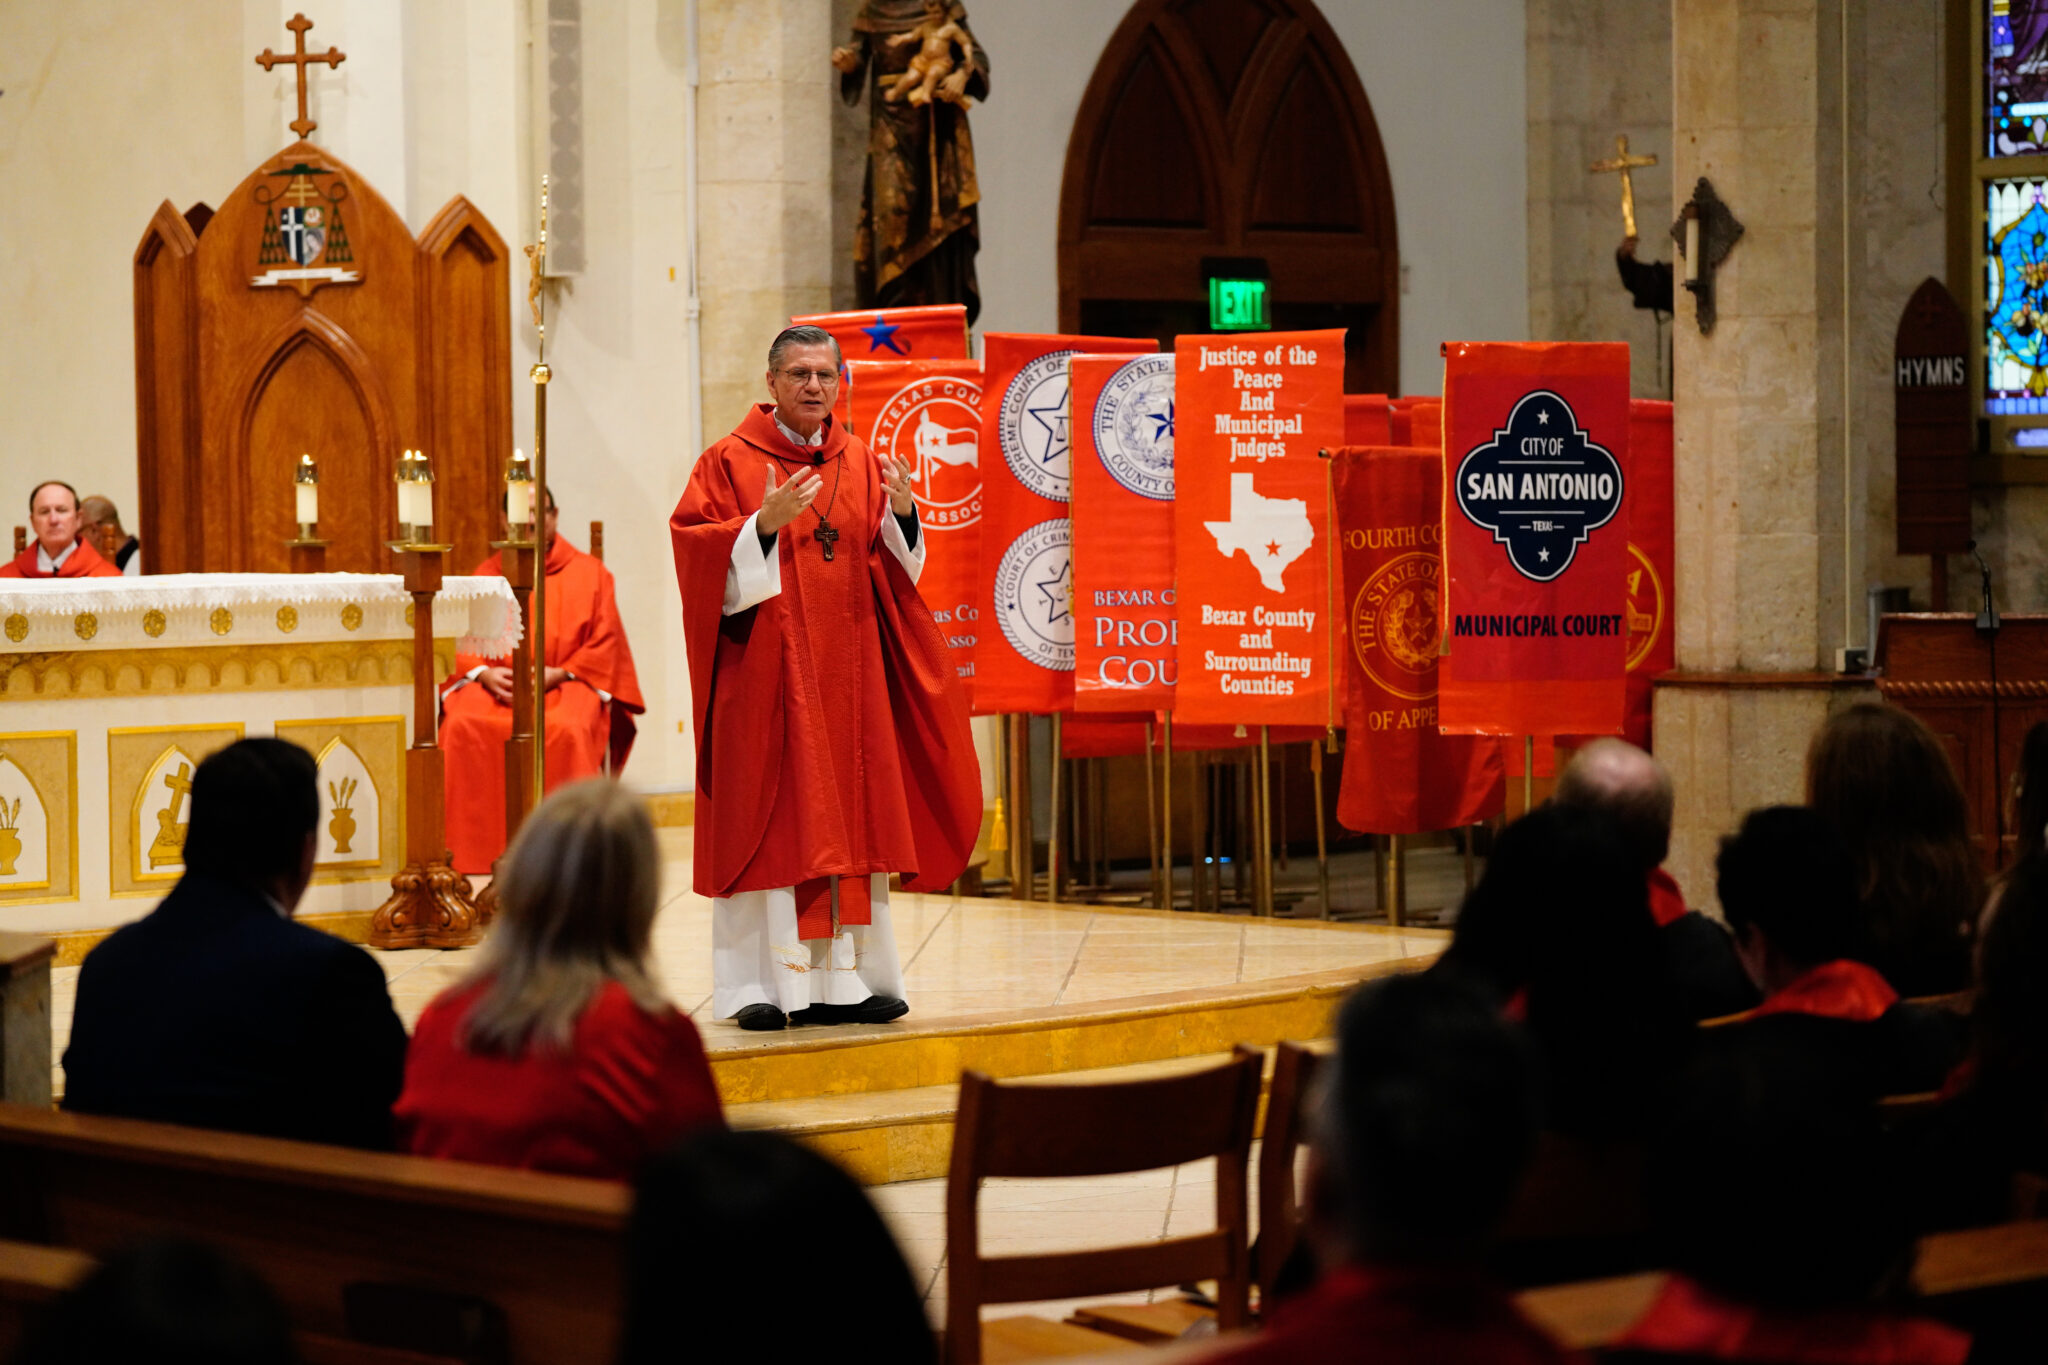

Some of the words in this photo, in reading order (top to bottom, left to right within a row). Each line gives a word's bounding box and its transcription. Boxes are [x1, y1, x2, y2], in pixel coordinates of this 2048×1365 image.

[1221, 281, 1265, 324] EXIT
[1046, 358, 1064, 373] OF
[1199, 345, 1257, 372] Justice
[1264, 345, 1284, 365] of
[1289, 345, 1317, 365] the
[1898, 356, 1965, 387] HYMNS
[1009, 368, 1042, 414] COURT
[1233, 368, 1283, 389] Peace
[882, 385, 933, 429] TEXAS
[944, 384, 982, 411] COU
[1102, 395, 1119, 433] THE
[1117, 360, 1169, 392] STATE
[1240, 391, 1275, 411] And
[1215, 413, 1303, 440] Municipal
[1008, 419, 1046, 486] SUPREME
[1230, 437, 1286, 463] Judges
[1521, 437, 1548, 456] CITY
[1549, 438, 1564, 456] OF
[1111, 454, 1161, 491] COUNTY
[1467, 473, 1514, 500] SAN
[1520, 473, 1614, 500] ANTONIO
[926, 499, 982, 523] ASSOC
[1344, 526, 1416, 550] FOURTH
[1533, 521, 1553, 532] TEXAS
[1006, 557, 1025, 599] COURT
[1025, 543, 1039, 557] OF
[1367, 561, 1416, 606] STATE
[1094, 590, 1156, 606] BEXAR
[933, 610, 952, 623] as
[1202, 605, 1247, 625] Bexar
[1253, 605, 1316, 633] County
[1455, 615, 1558, 637] MUNICIPAL
[1562, 615, 1622, 637] COURT
[946, 634, 977, 648] sso
[1240, 629, 1274, 649] and
[1359, 609, 1377, 654] THE
[1039, 643, 1053, 655] OF
[1205, 650, 1312, 678] Surrounding
[1221, 673, 1294, 695] Counties
[1368, 710, 1394, 731] OF
